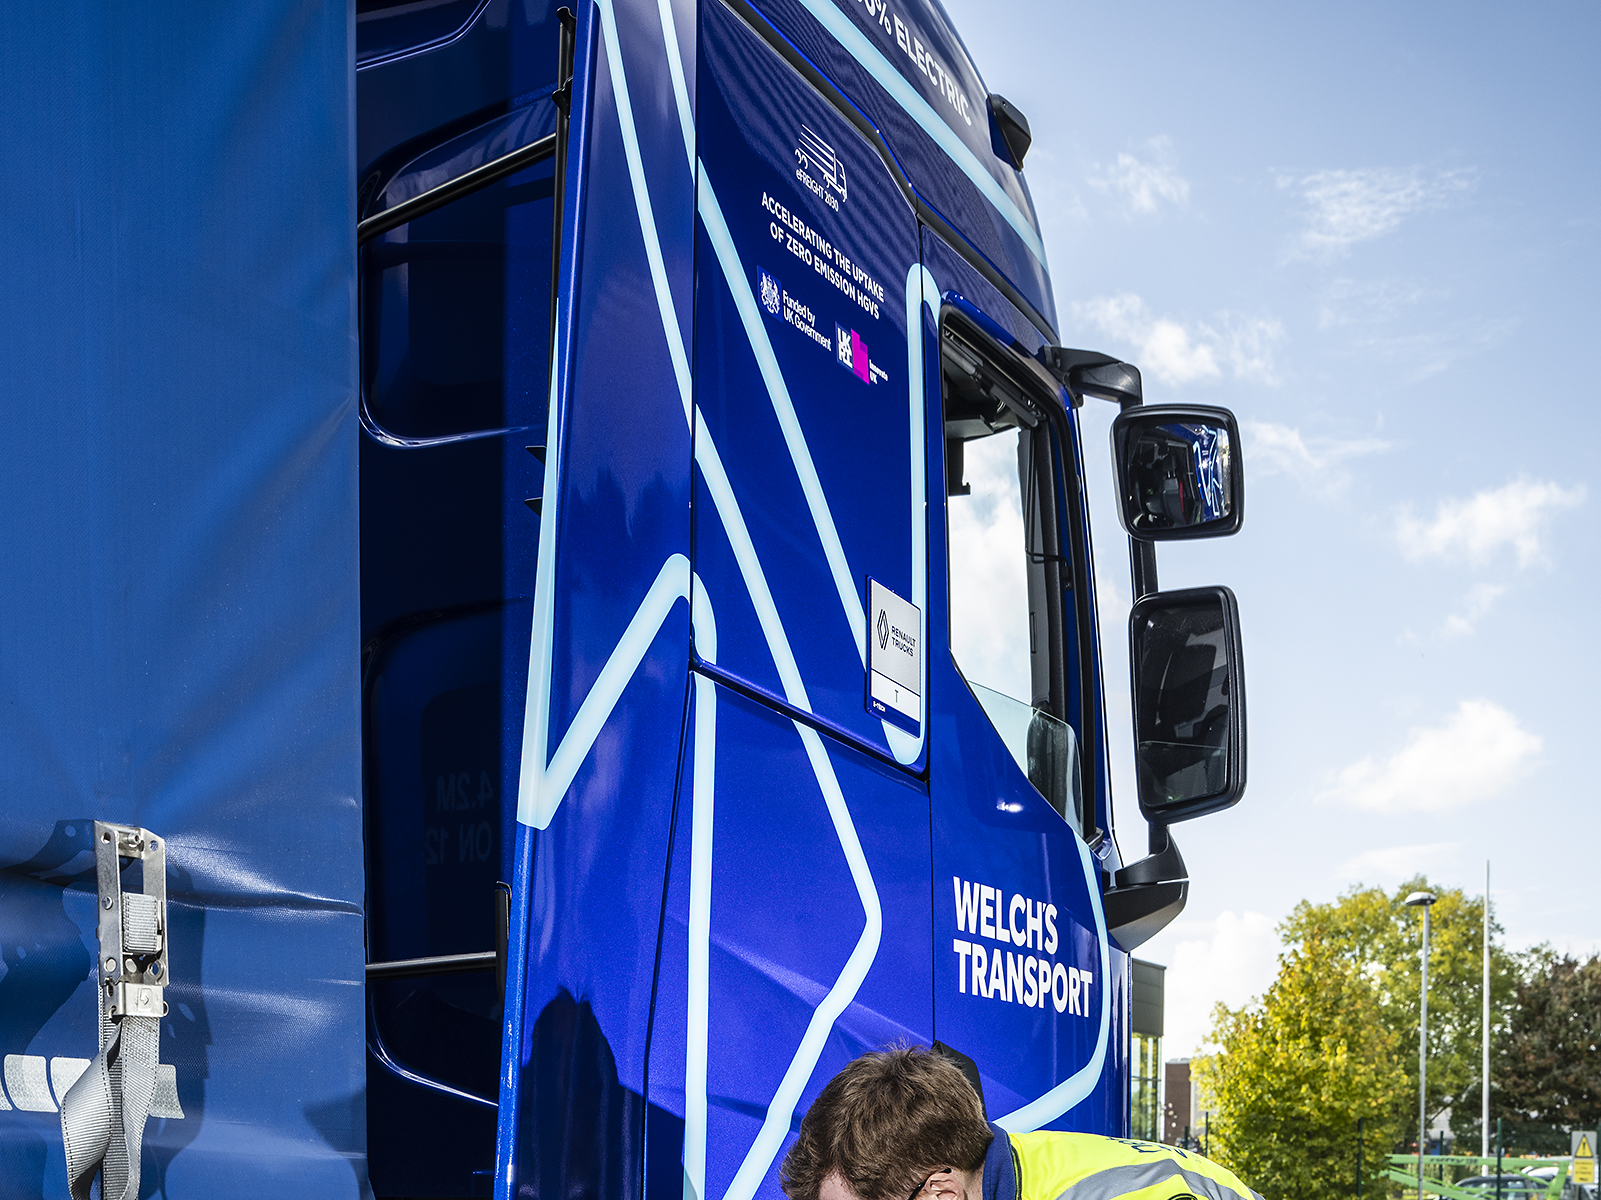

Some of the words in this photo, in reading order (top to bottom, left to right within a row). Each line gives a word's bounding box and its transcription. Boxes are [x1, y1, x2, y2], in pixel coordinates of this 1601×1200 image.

[893, 13, 972, 127] ELECTRIC
[796, 168, 824, 200] eFREIGHT
[825, 189, 839, 212] 2030
[762, 192, 833, 259] ACCELERATING
[833, 248, 851, 275] THE
[852, 263, 884, 303] UPTAKE
[770, 222, 784, 243] OF
[786, 234, 812, 267] ZERO
[814, 259, 856, 304] EMISSION
[857, 291, 880, 320] HGVS
[783, 290, 807, 319] Funded
[807, 307, 816, 327] by
[783, 305, 795, 325] UK
[795, 314, 832, 351] Government
[891, 625, 915, 646] RENAULT
[892, 636, 914, 657] TRUCKS
[894, 689, 899, 704] T
[952, 876, 1058, 955] WELCH'S
[953, 939, 1093, 1018] TRANSPORT
